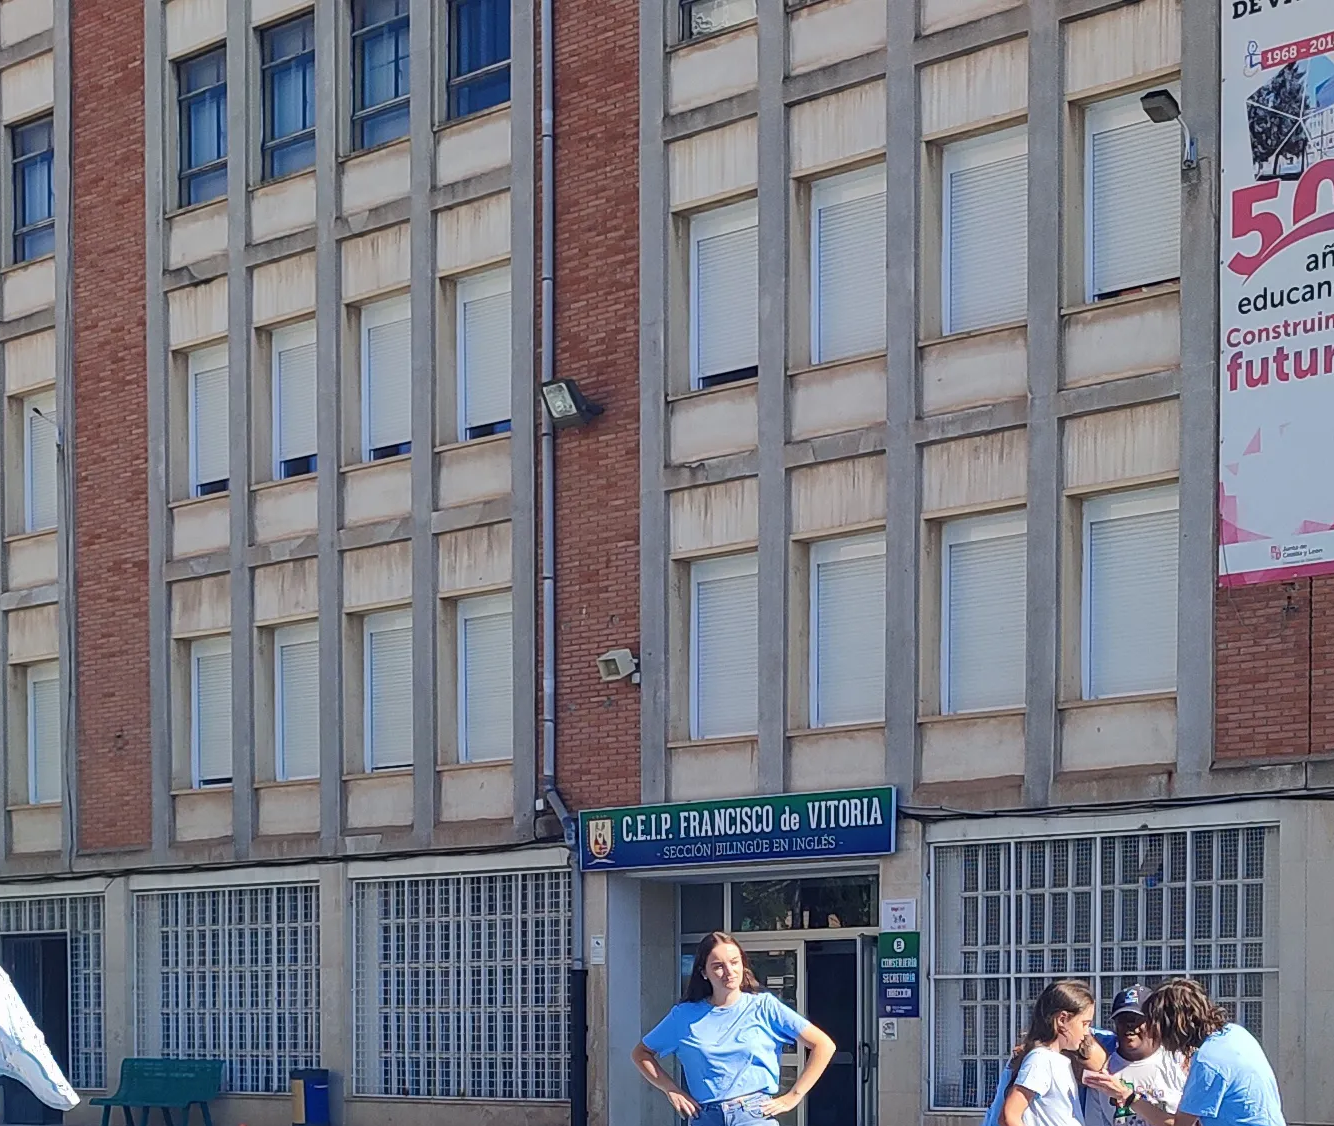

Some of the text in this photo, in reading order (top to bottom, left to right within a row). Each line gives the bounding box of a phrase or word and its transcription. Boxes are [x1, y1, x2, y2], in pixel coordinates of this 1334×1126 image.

[1232, 0, 1262, 19] DE
[1266, 45, 1297, 64] 1968
[622, 797, 883, 842] C.E.I.P. FRANCISCO de VITORIA
[663, 842, 712, 859] SECCIÓN
[715, 838, 770, 855] BILINGÜE
[773, 838, 789, 852] EN
[792, 834, 836, 850] INGLÉS
